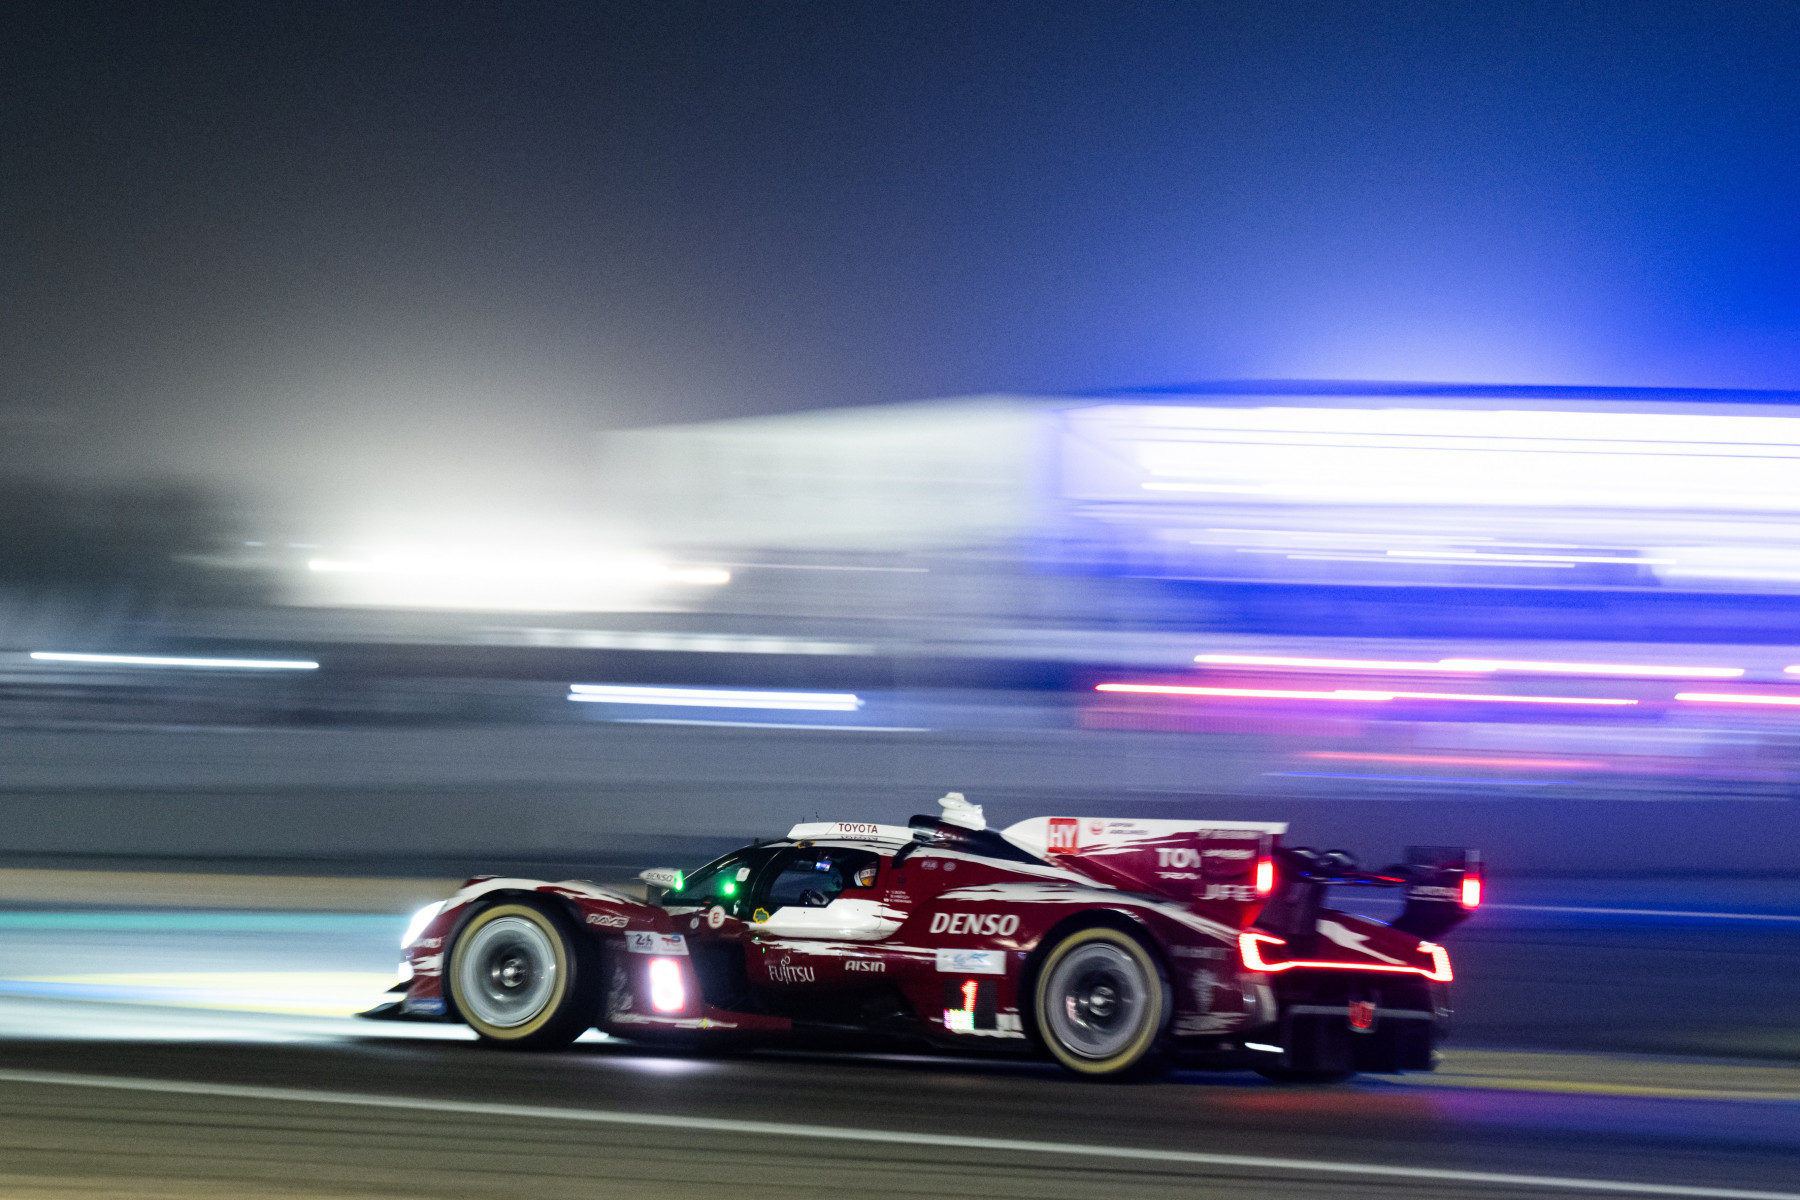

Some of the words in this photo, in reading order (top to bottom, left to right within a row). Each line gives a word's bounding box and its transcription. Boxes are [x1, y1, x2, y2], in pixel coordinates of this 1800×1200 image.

[838, 823, 878, 834] TOYOTA
[1048, 824, 1078, 848] HY
[646, 872, 674, 882] DENSO
[586, 913, 631, 929] RAYS
[929, 912, 1020, 936] DENSO
[768, 957, 815, 984] FUJITSU
[845, 960, 886, 973] AISIN
